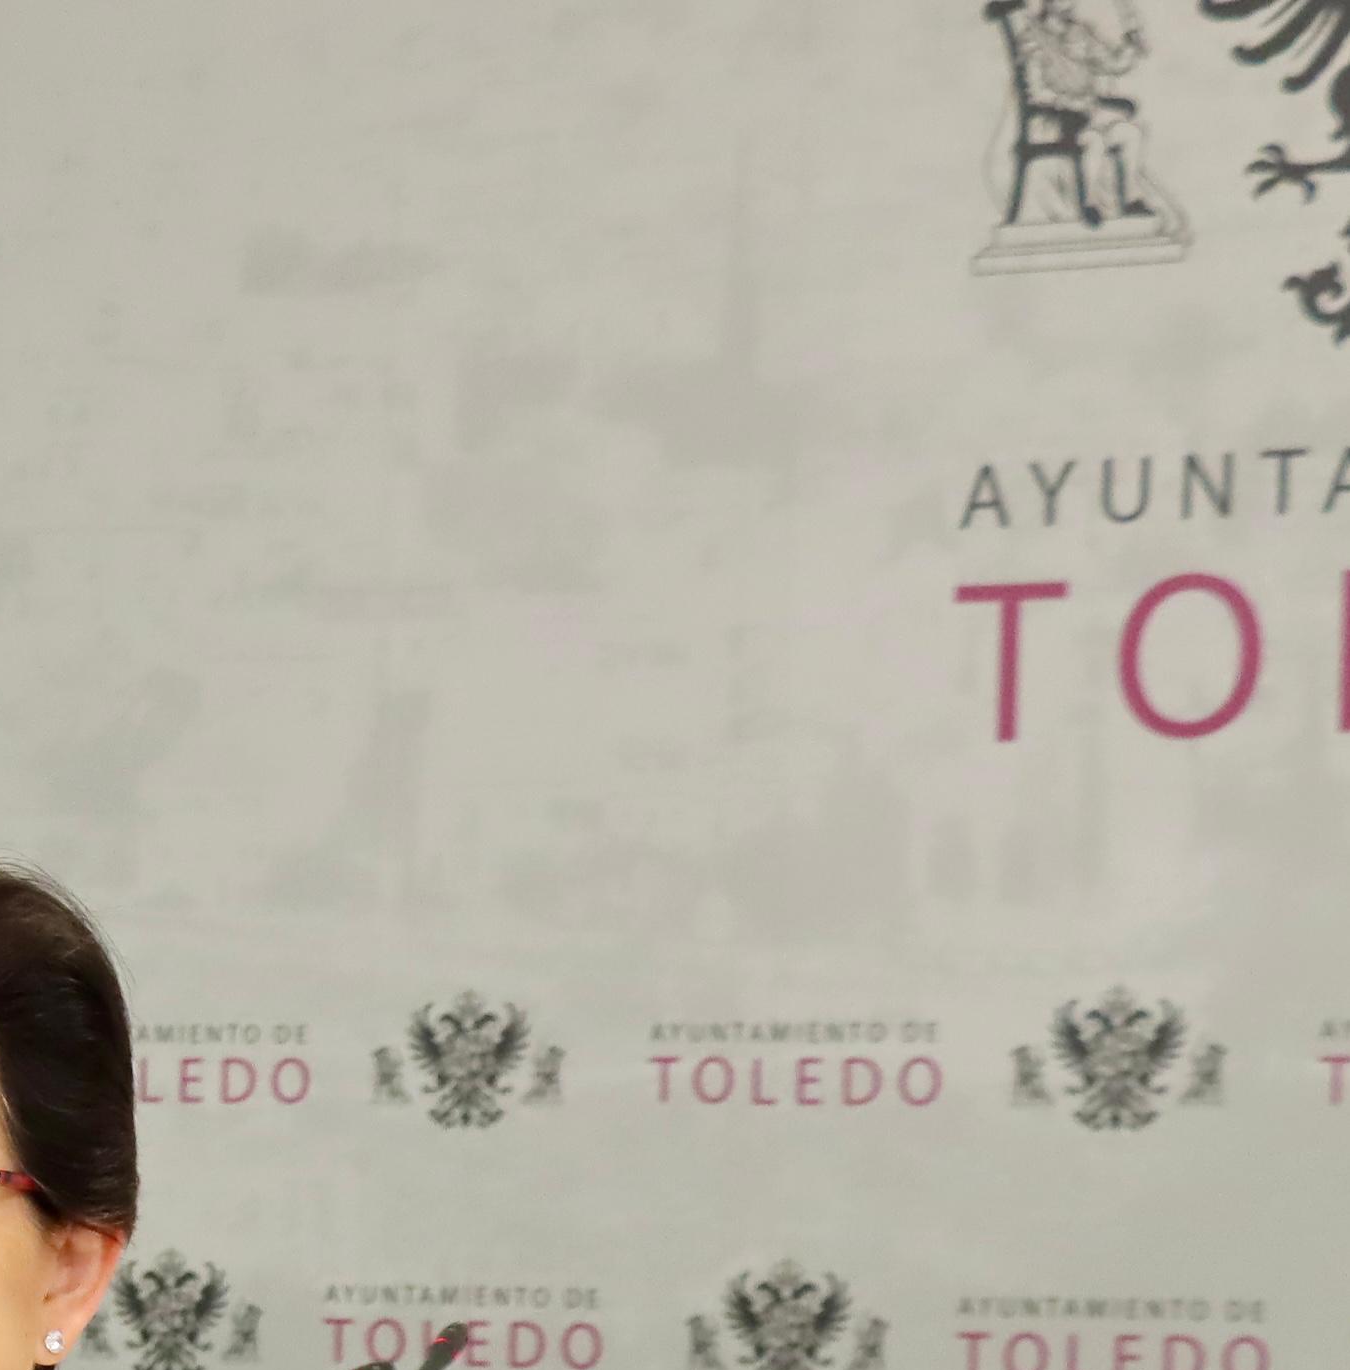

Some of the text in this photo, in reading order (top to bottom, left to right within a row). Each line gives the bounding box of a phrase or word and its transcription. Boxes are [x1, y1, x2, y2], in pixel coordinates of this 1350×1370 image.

[954, 569, 1350, 743] TO
[137, 1023, 309, 1045] AMIENTO DE
[650, 1021, 939, 1044] AYUNTAMIENTO DE
[136, 1057, 312, 1105] LEDO
[649, 1056, 944, 1107] TOLEDO
[325, 1284, 601, 1310] AYUNTAMIENTO DE
[957, 1297, 1267, 1324] AYUNTAMIENTO DE
